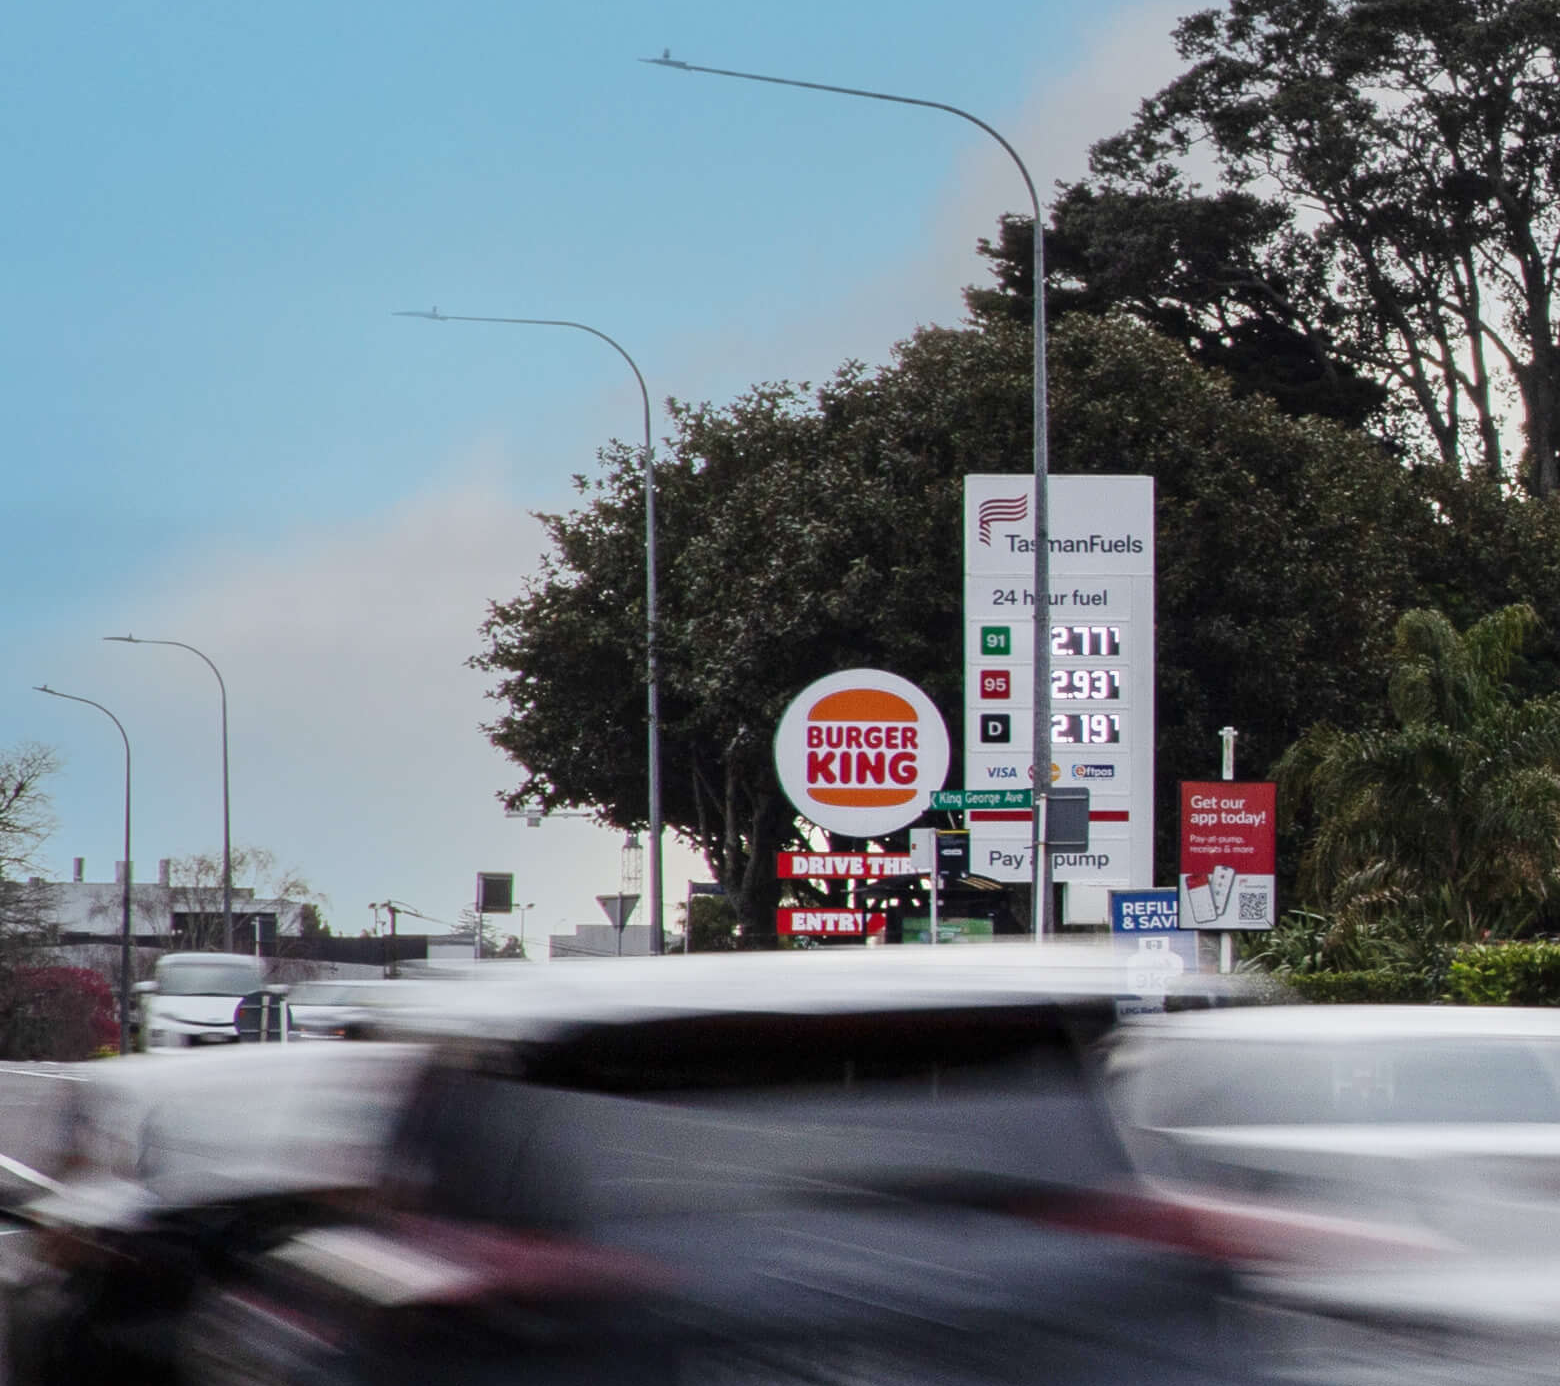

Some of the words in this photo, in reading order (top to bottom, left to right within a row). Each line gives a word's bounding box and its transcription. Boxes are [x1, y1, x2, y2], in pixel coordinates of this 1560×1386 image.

[992, 589, 1018, 605] 24
[1023, 589, 1068, 605] hur
[1072, 589, 1108, 605] fuel
[986, 634, 1006, 648] 91
[984, 678, 1006, 692] 95
[988, 721, 1002, 735] D
[807, 726, 919, 749] BURGER
[807, 751, 919, 785] KING
[987, 767, 1017, 778] VISA
[939, 792, 963, 806] King
[965, 793, 1000, 806] George
[1004, 792, 1024, 803] Ave
[1190, 795, 1217, 809] Get
[1220, 798, 1246, 809] our
[1190, 814, 1217, 826] app
[1221, 811, 1266, 827] today!
[792, 856, 864, 875] DRIVE
[867, 856, 931, 875] THR
[989, 850, 1025, 869] Pay
[1053, 854, 1110, 869] pump
[1122, 916, 1135, 929] &
